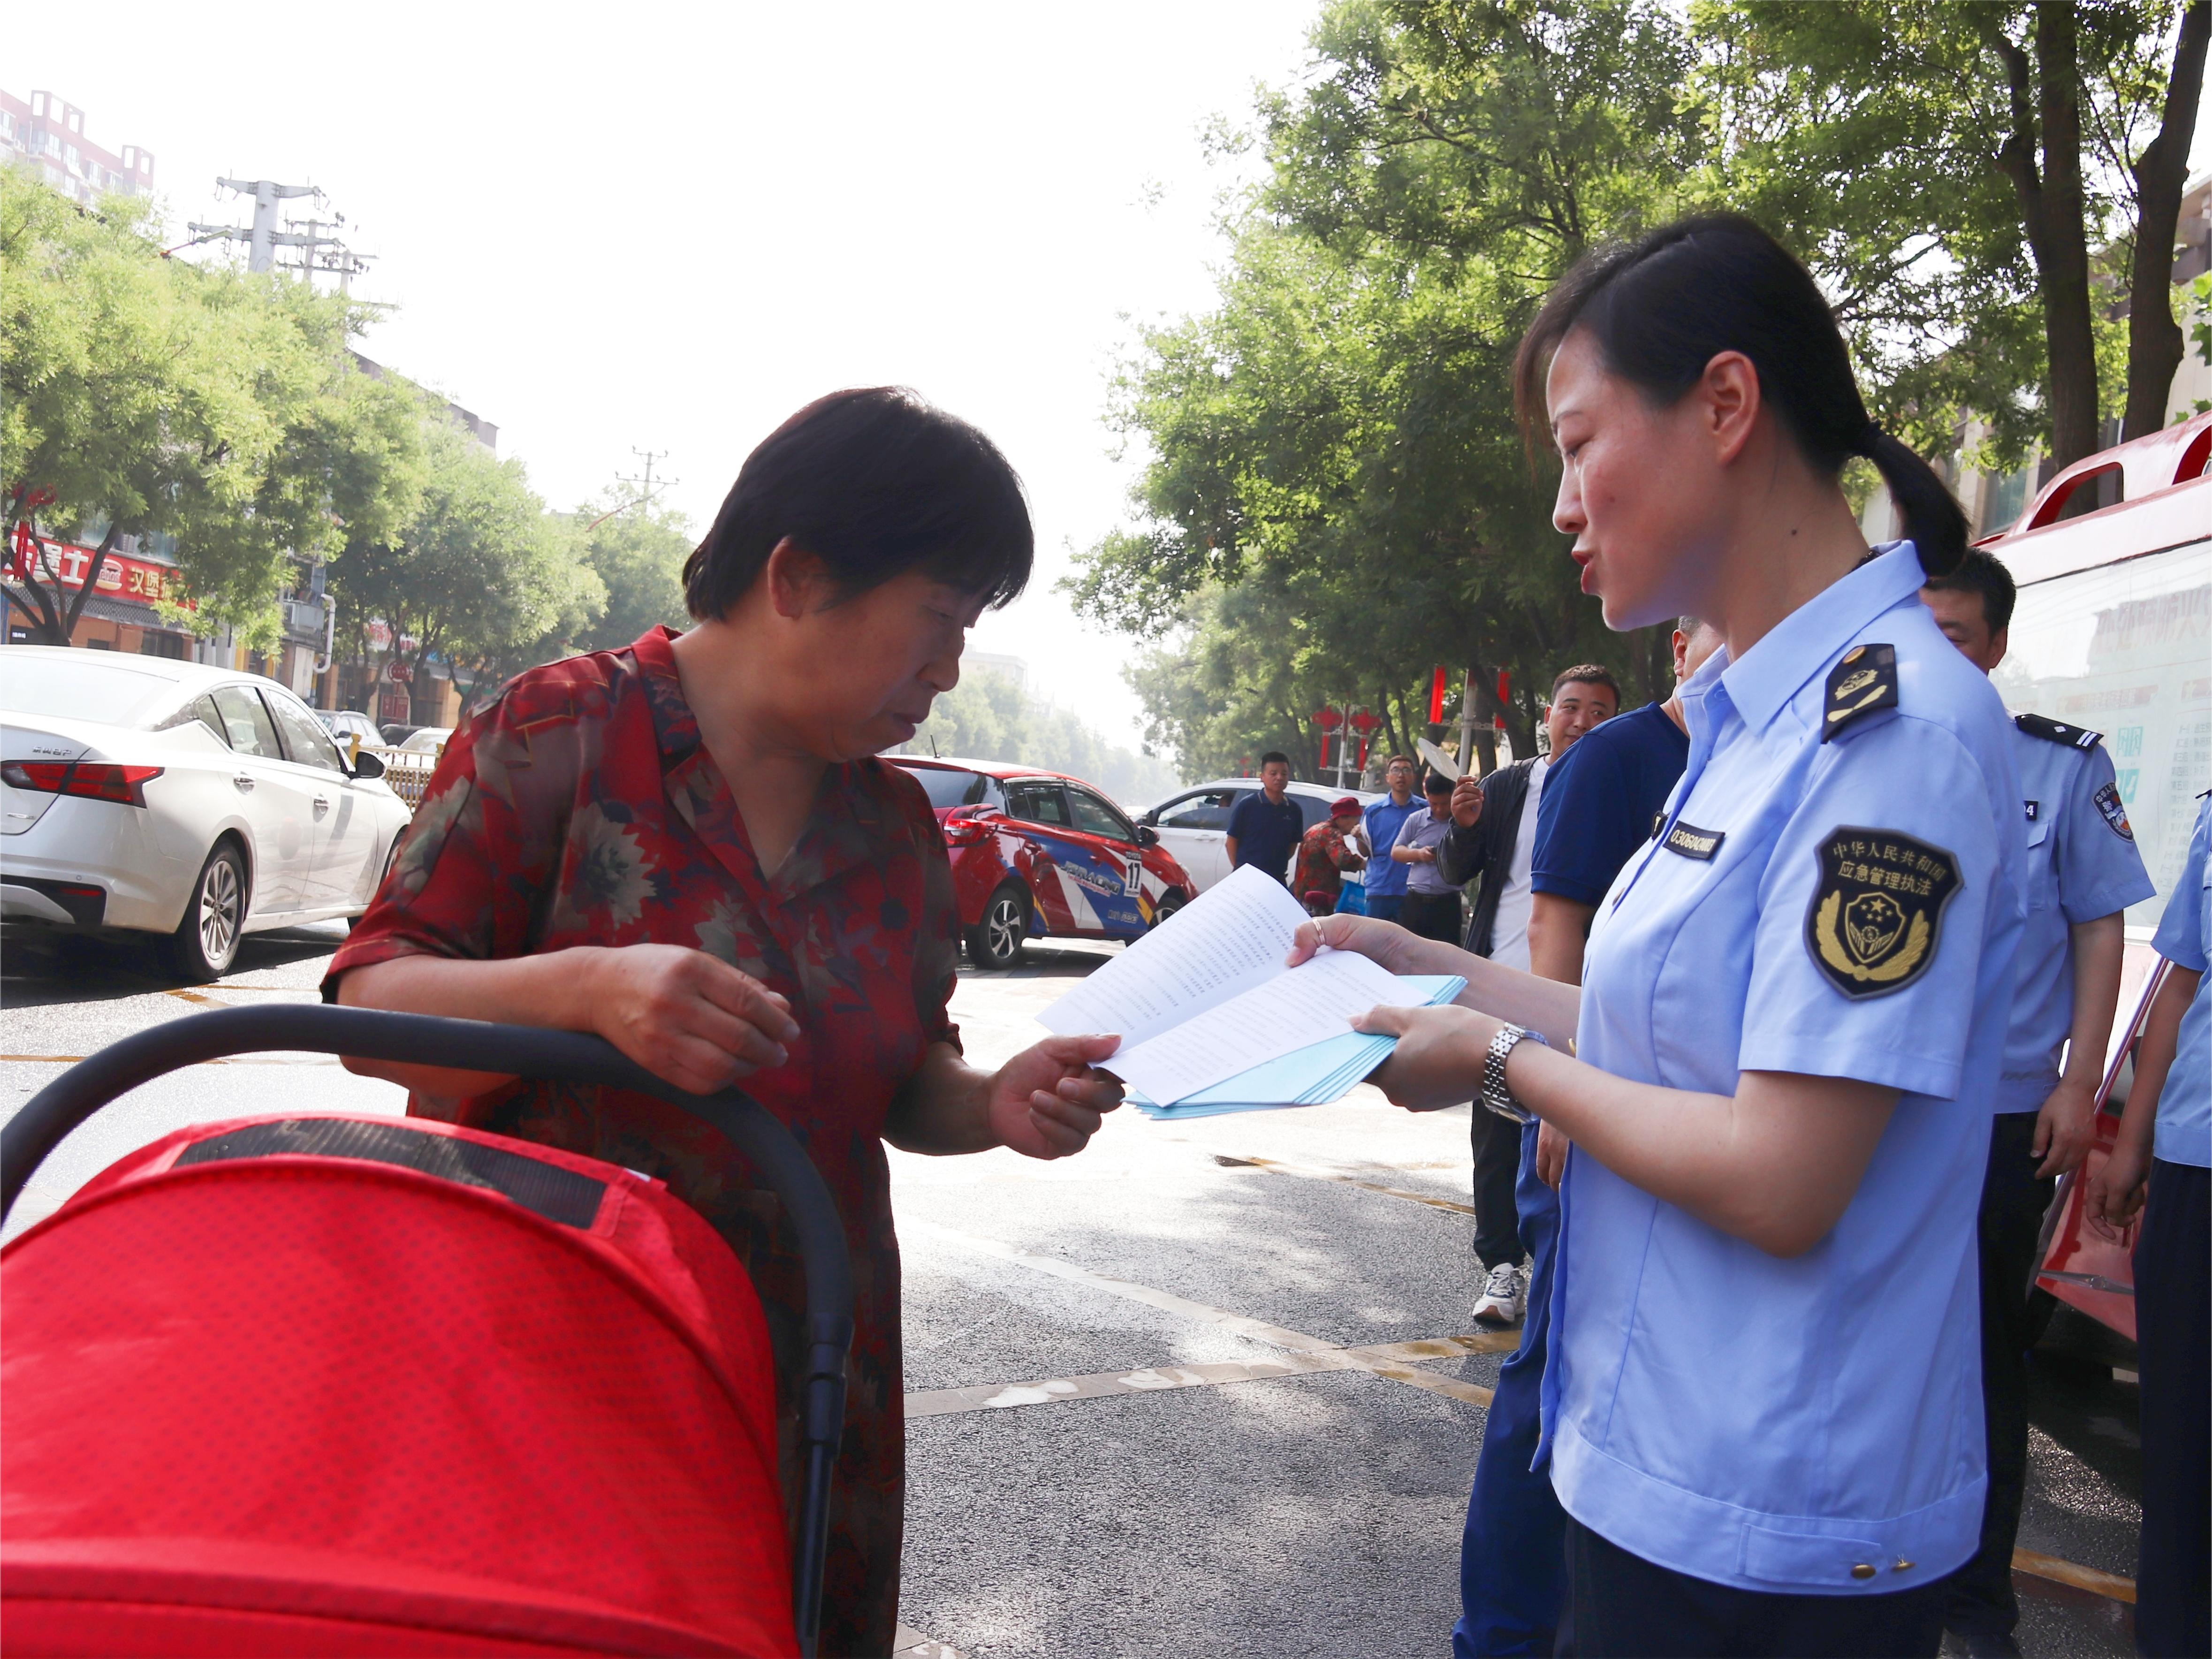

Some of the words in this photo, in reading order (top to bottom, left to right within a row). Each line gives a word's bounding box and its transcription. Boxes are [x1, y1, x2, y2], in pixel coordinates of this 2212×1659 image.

[2023, 804, 2034, 816] 4
[1128, 862, 1140, 889] 17
[1833, 841, 1946, 881] 中华人民共和国
[1838, 860, 1933, 896] 应急管理执法
